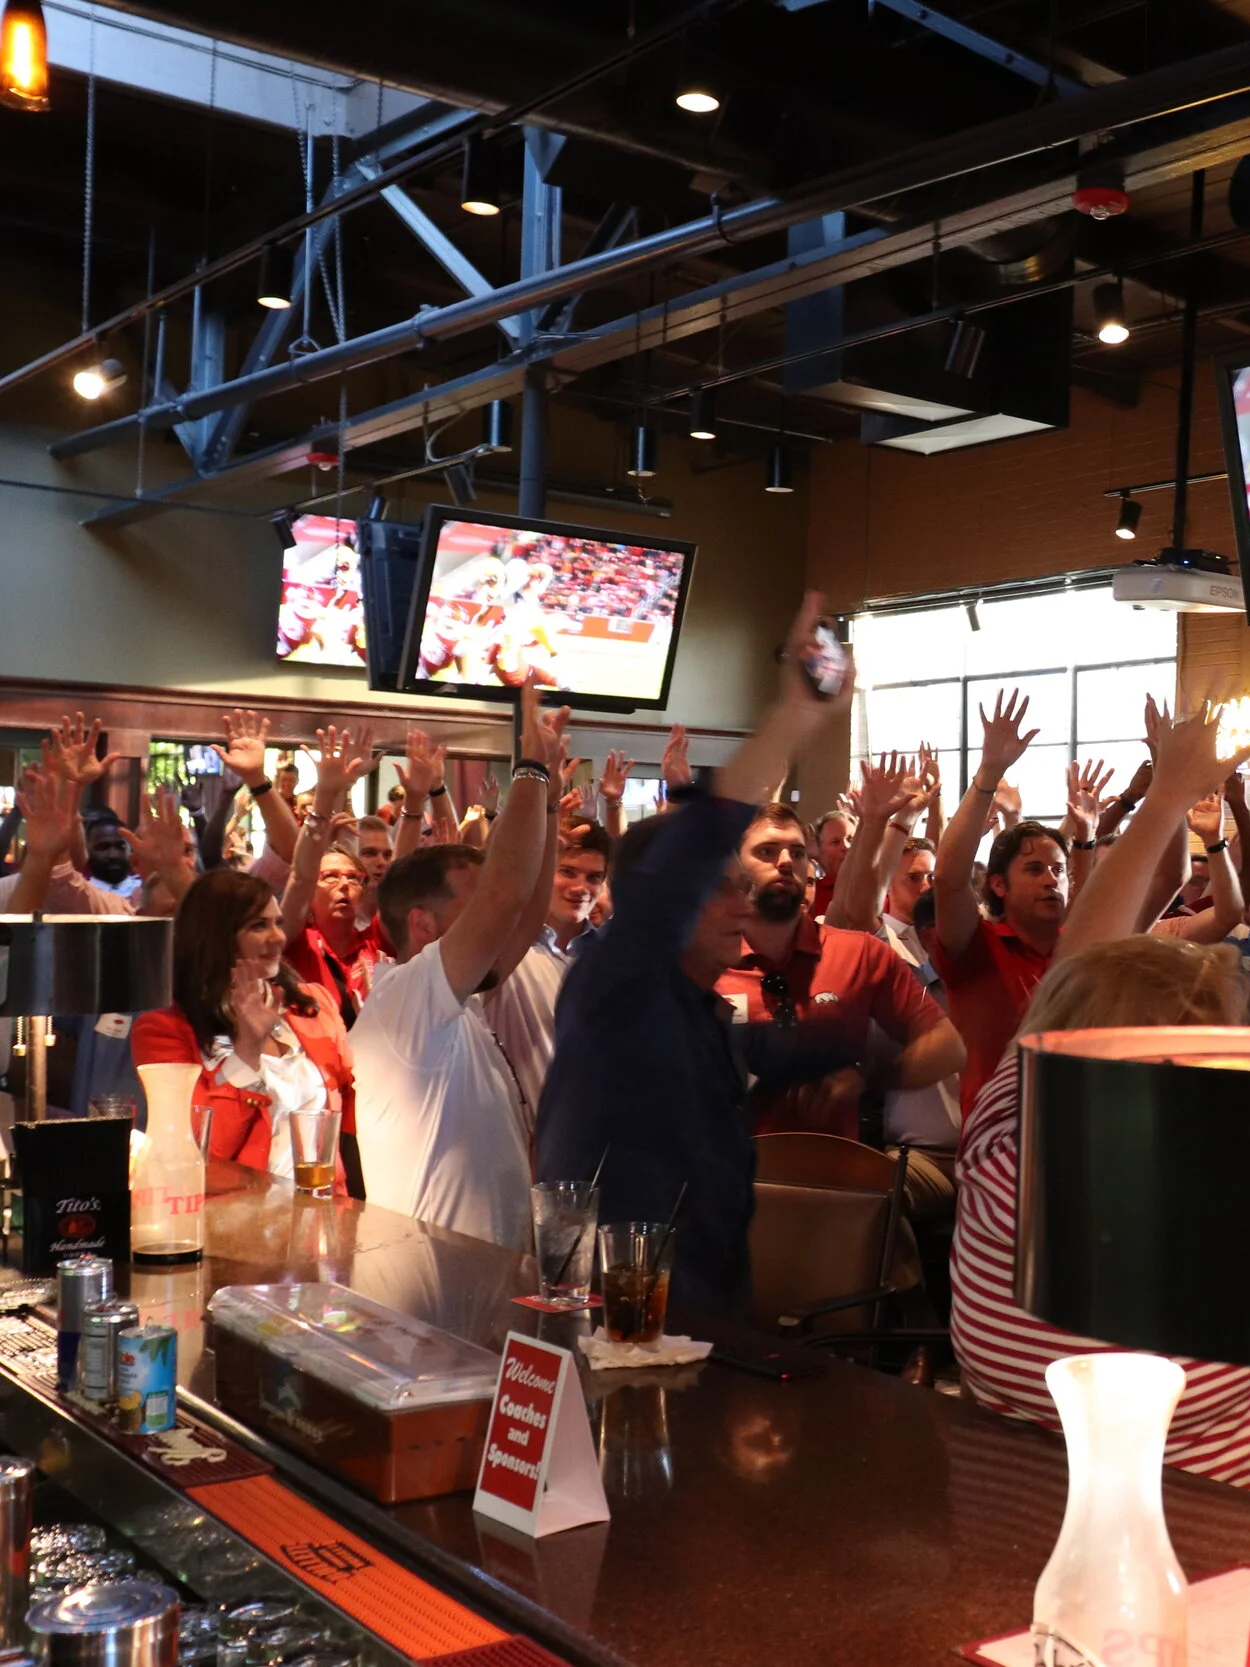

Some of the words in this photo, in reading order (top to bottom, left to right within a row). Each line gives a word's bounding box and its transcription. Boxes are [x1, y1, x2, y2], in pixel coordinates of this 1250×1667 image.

[56, 1197, 101, 1214] Tito's
[50, 1235, 106, 1252] Handmade
[505, 1356, 556, 1394] Welcome
[499, 1393, 547, 1429] Coaches
[507, 1427, 530, 1446] and
[487, 1443, 542, 1481] Sponsors!
